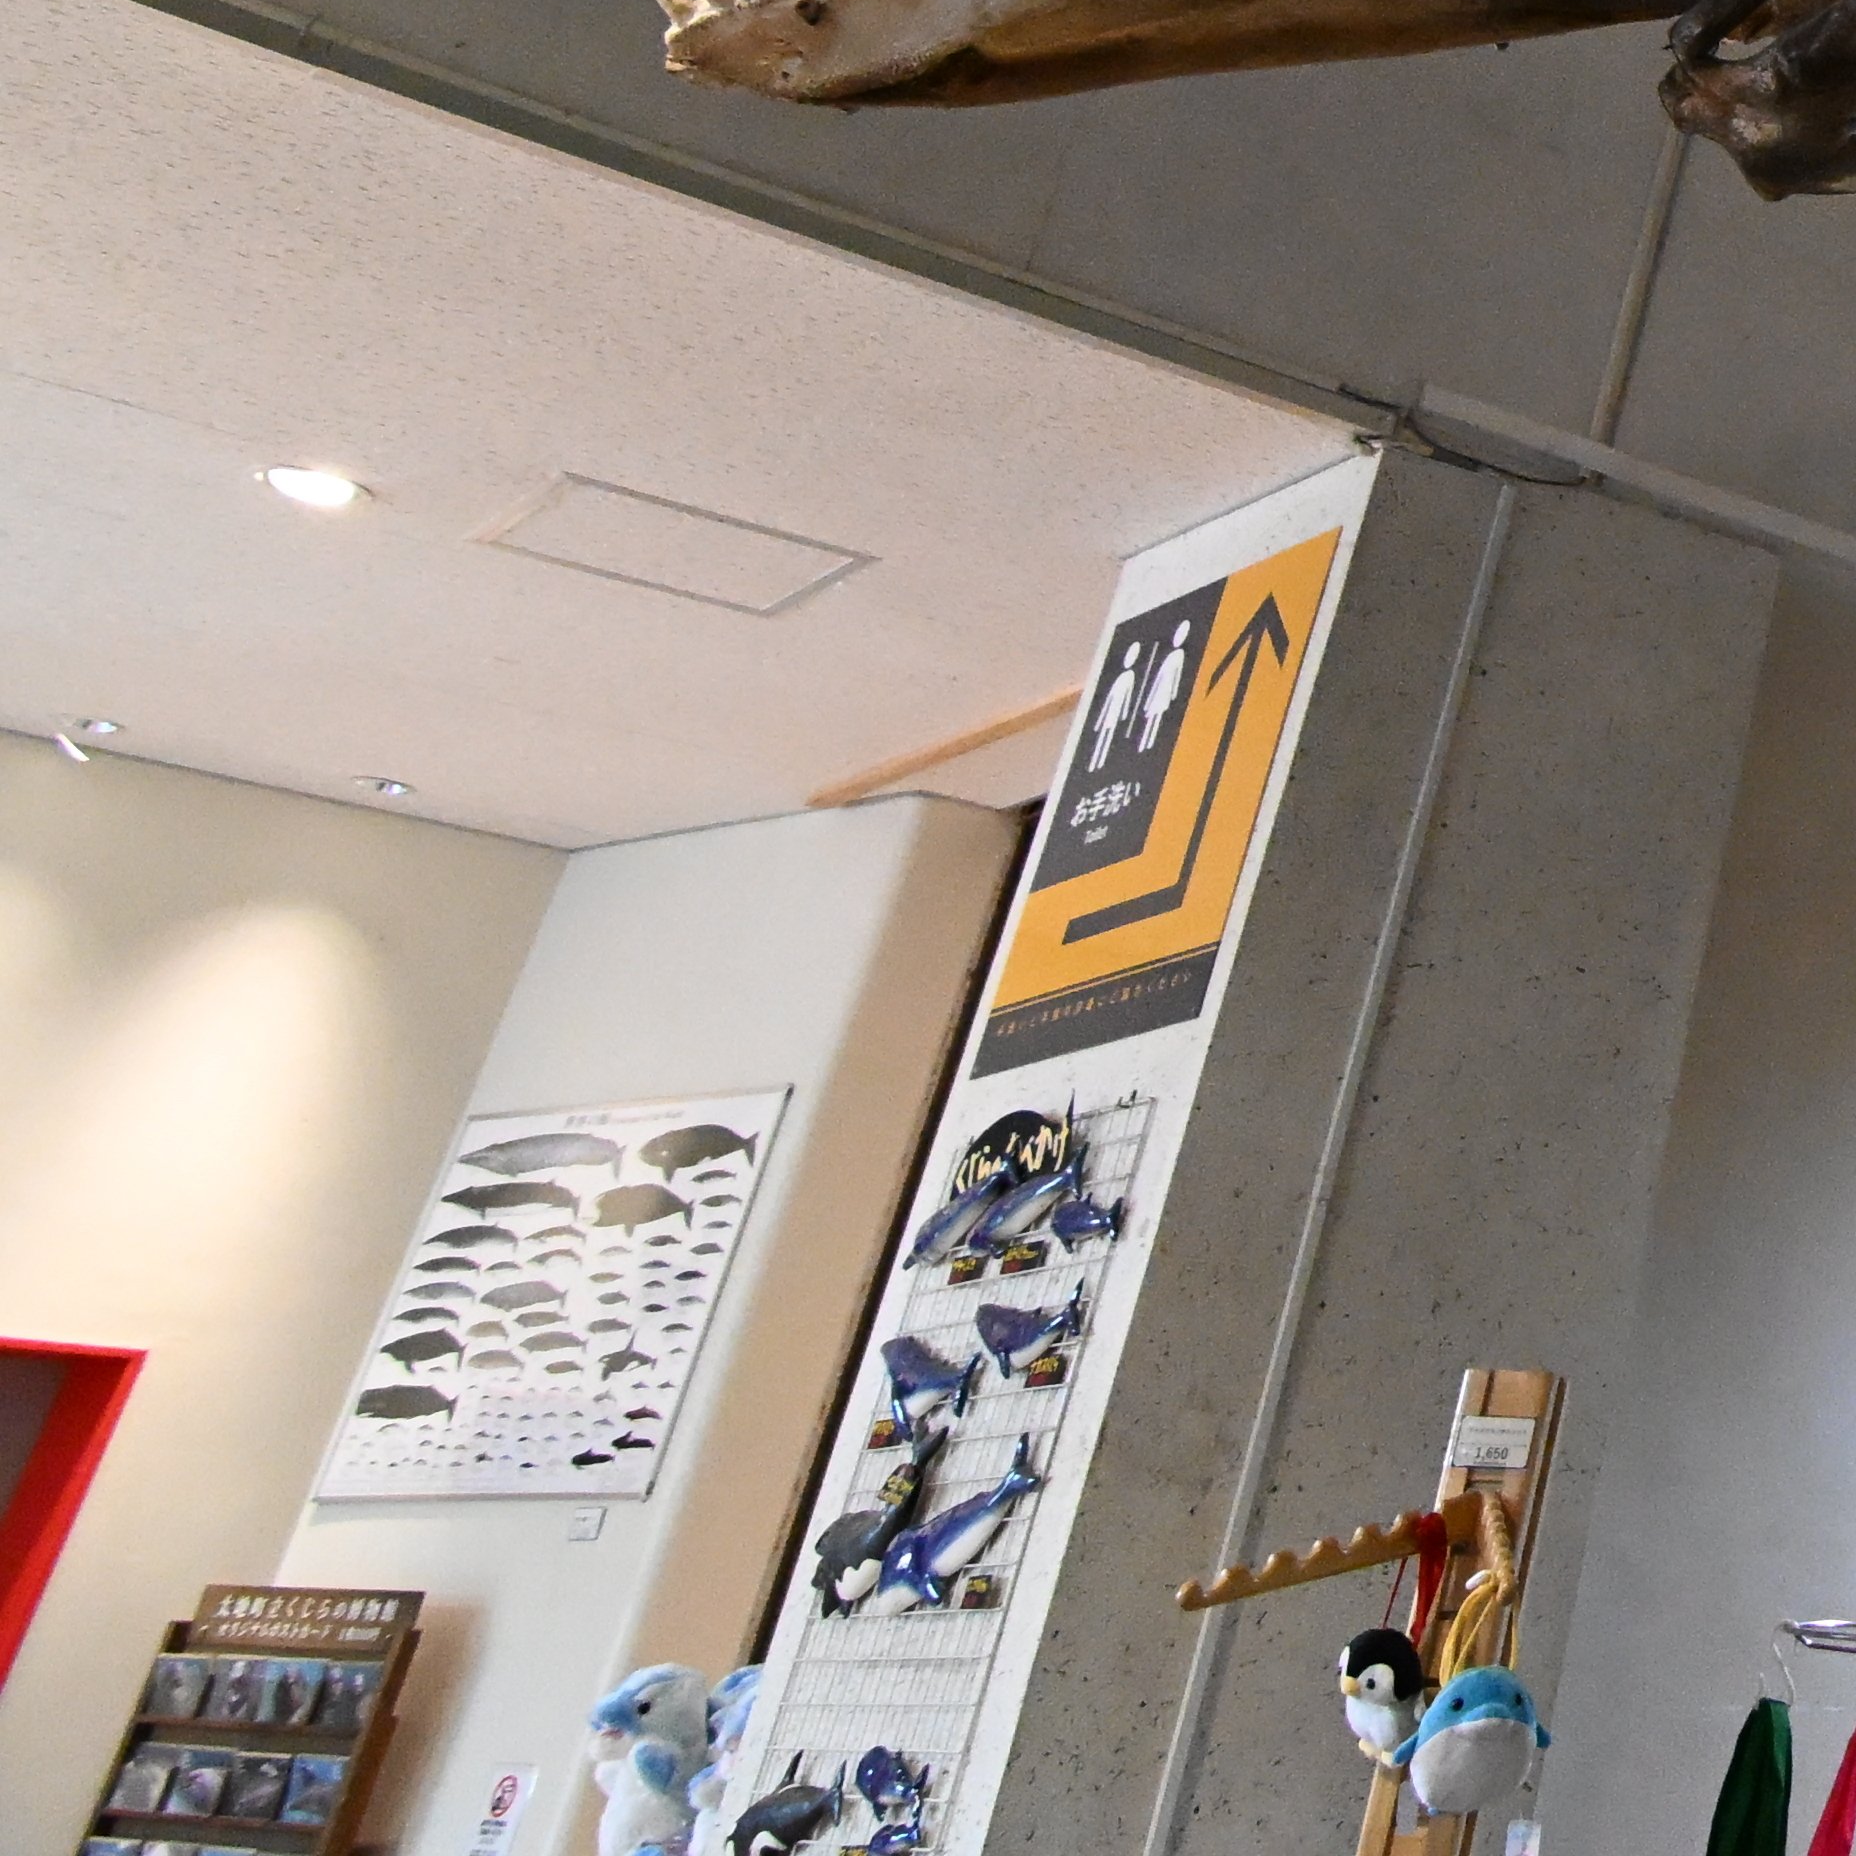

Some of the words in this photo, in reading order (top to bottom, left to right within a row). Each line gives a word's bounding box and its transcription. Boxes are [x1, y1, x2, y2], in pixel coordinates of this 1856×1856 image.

[1070, 781, 1141, 827] お手洗い
[1475, 1447, 1509, 1461] 1,650
